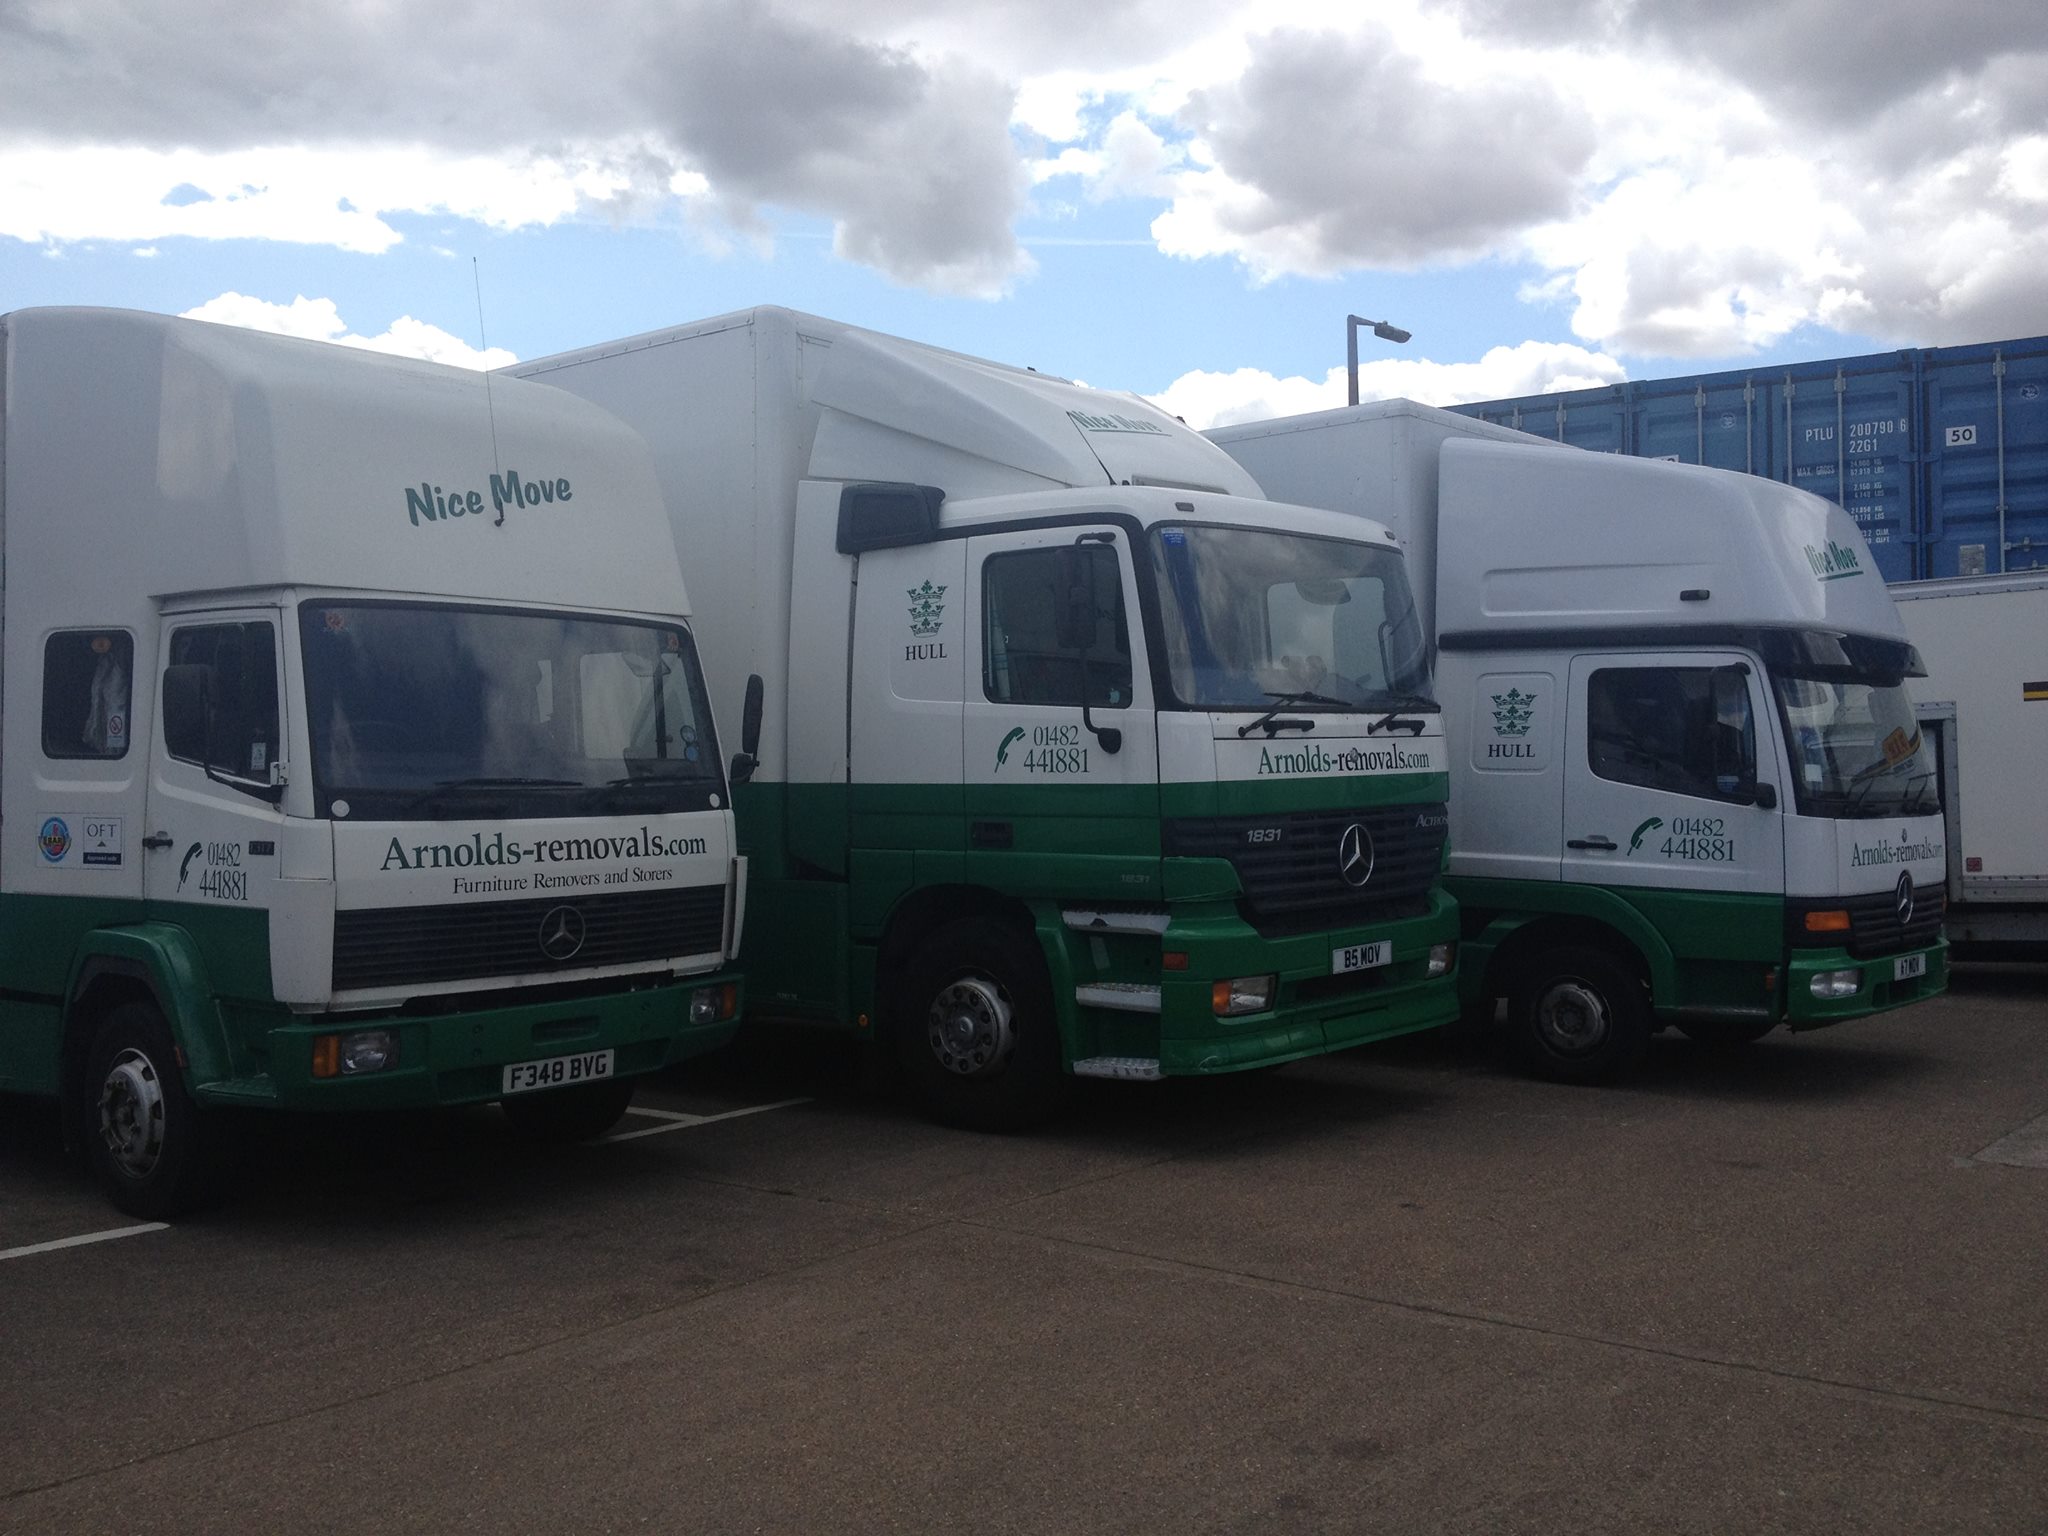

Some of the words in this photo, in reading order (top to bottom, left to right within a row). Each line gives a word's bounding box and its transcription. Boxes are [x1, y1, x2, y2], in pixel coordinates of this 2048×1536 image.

[1067, 410, 1118, 429] Nice
[1109, 414, 1162, 432] Move
[1805, 427, 1834, 442] PTLU
[1849, 420, 1894, 437] 200790
[1899, 418, 1908, 432] 6
[1849, 440, 1878, 453] 22G1
[1950, 428, 1973, 443] 50
[405, 482, 485, 527] Nice
[489, 470, 573, 511] Move
[905, 643, 947, 660] HULL
[1033, 725, 1079, 746] 01482
[1023, 749, 1090, 773] 441881
[1258, 743, 1430, 774] Arnolds-removals.com
[1487, 744, 1536, 758] HULL
[87, 823, 117, 837] OFT
[1247, 828, 1282, 843] 1831
[1672, 817, 1725, 837] 01482
[207, 842, 240, 867] 01482
[380, 826, 707, 871] Arnolds-removals.com
[1660, 837, 1736, 861] 441881
[199, 869, 248, 900] 441881
[453, 876, 529, 894] Furniture
[533, 872, 600, 890] Removers
[604, 868, 628, 885] and
[632, 866, 673, 882] Storers
[1344, 949, 1358, 968] B5
[1360, 945, 1381, 965] MOV
[510, 1061, 564, 1089] F348
[570, 1054, 606, 1079] BVG
